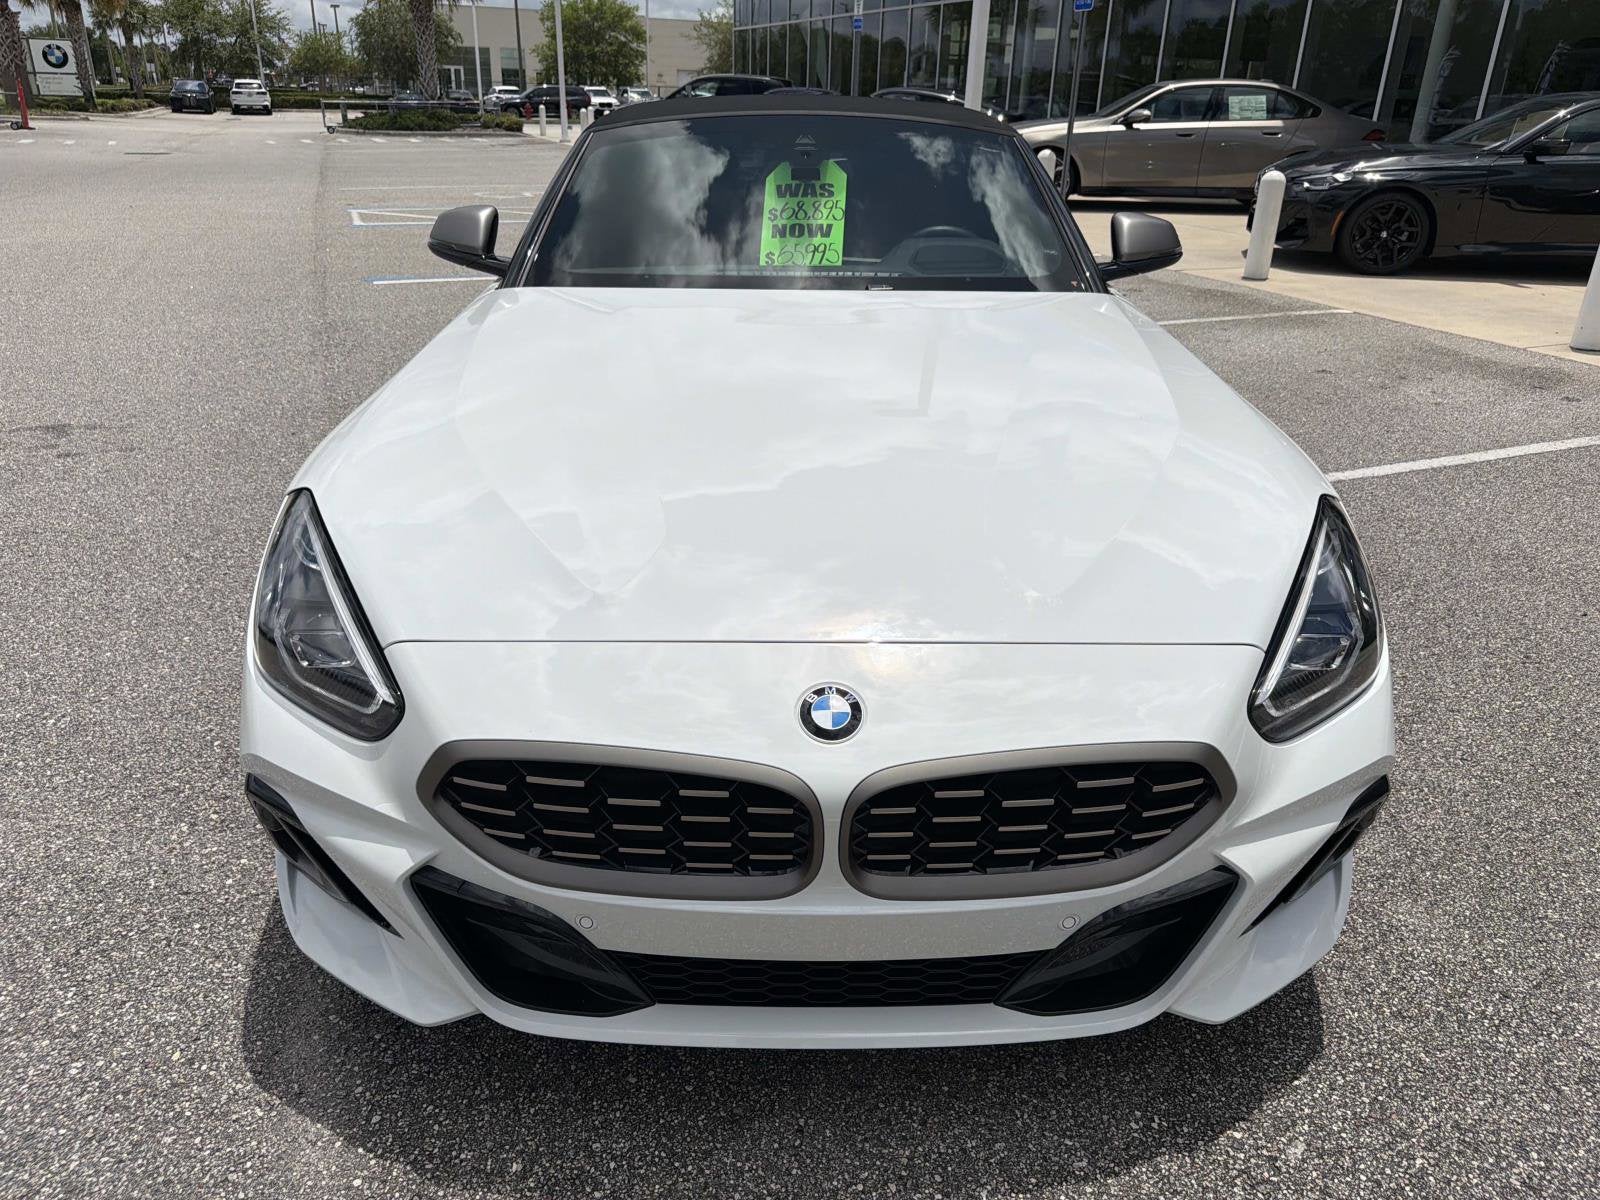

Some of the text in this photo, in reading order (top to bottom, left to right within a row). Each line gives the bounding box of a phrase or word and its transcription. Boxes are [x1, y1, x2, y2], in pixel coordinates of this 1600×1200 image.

[776, 183, 834, 198] WAS
[771, 223, 834, 239] NOW
[805, 686, 857, 703] BMW
